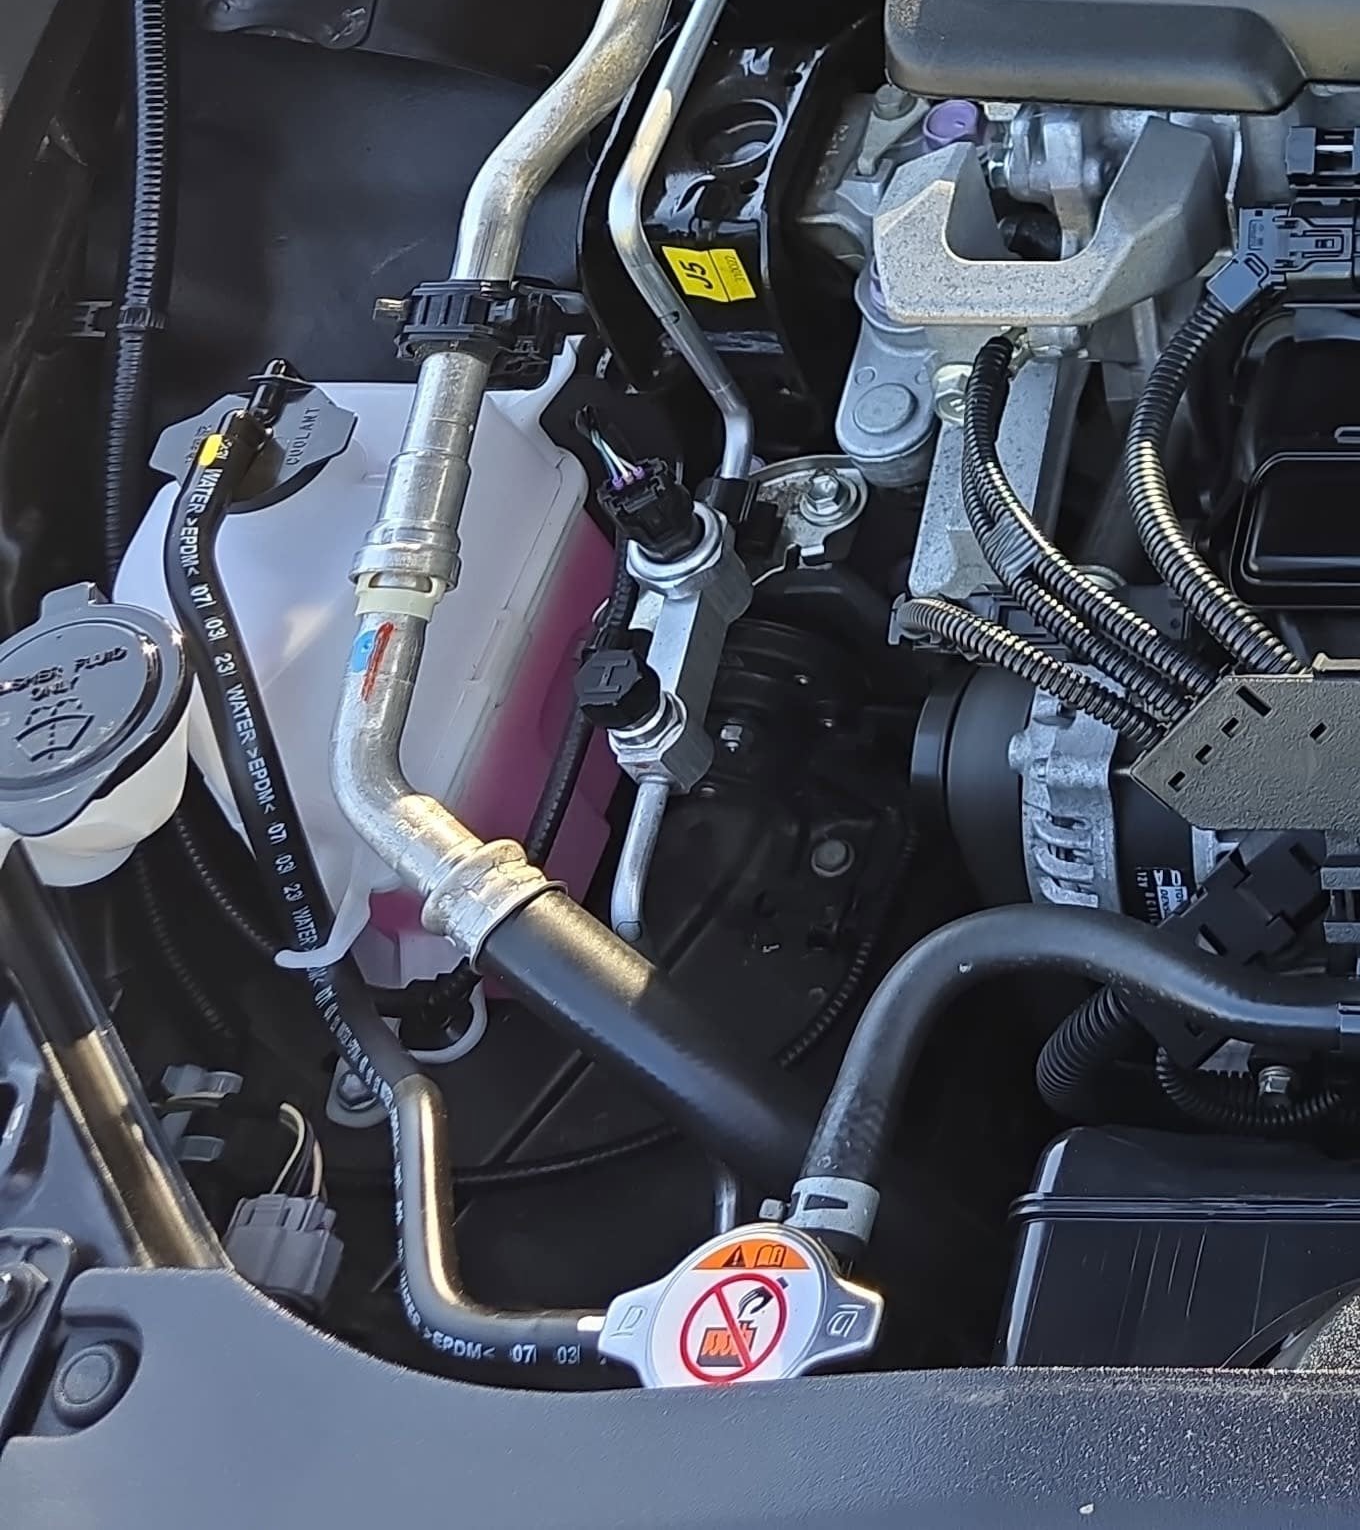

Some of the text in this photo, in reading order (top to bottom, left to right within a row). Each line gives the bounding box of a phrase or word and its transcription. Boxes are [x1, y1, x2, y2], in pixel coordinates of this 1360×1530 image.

[679, 259, 714, 290] J5
[186, 468, 223, 514] WATER
[226, 683, 258, 746] WATER
